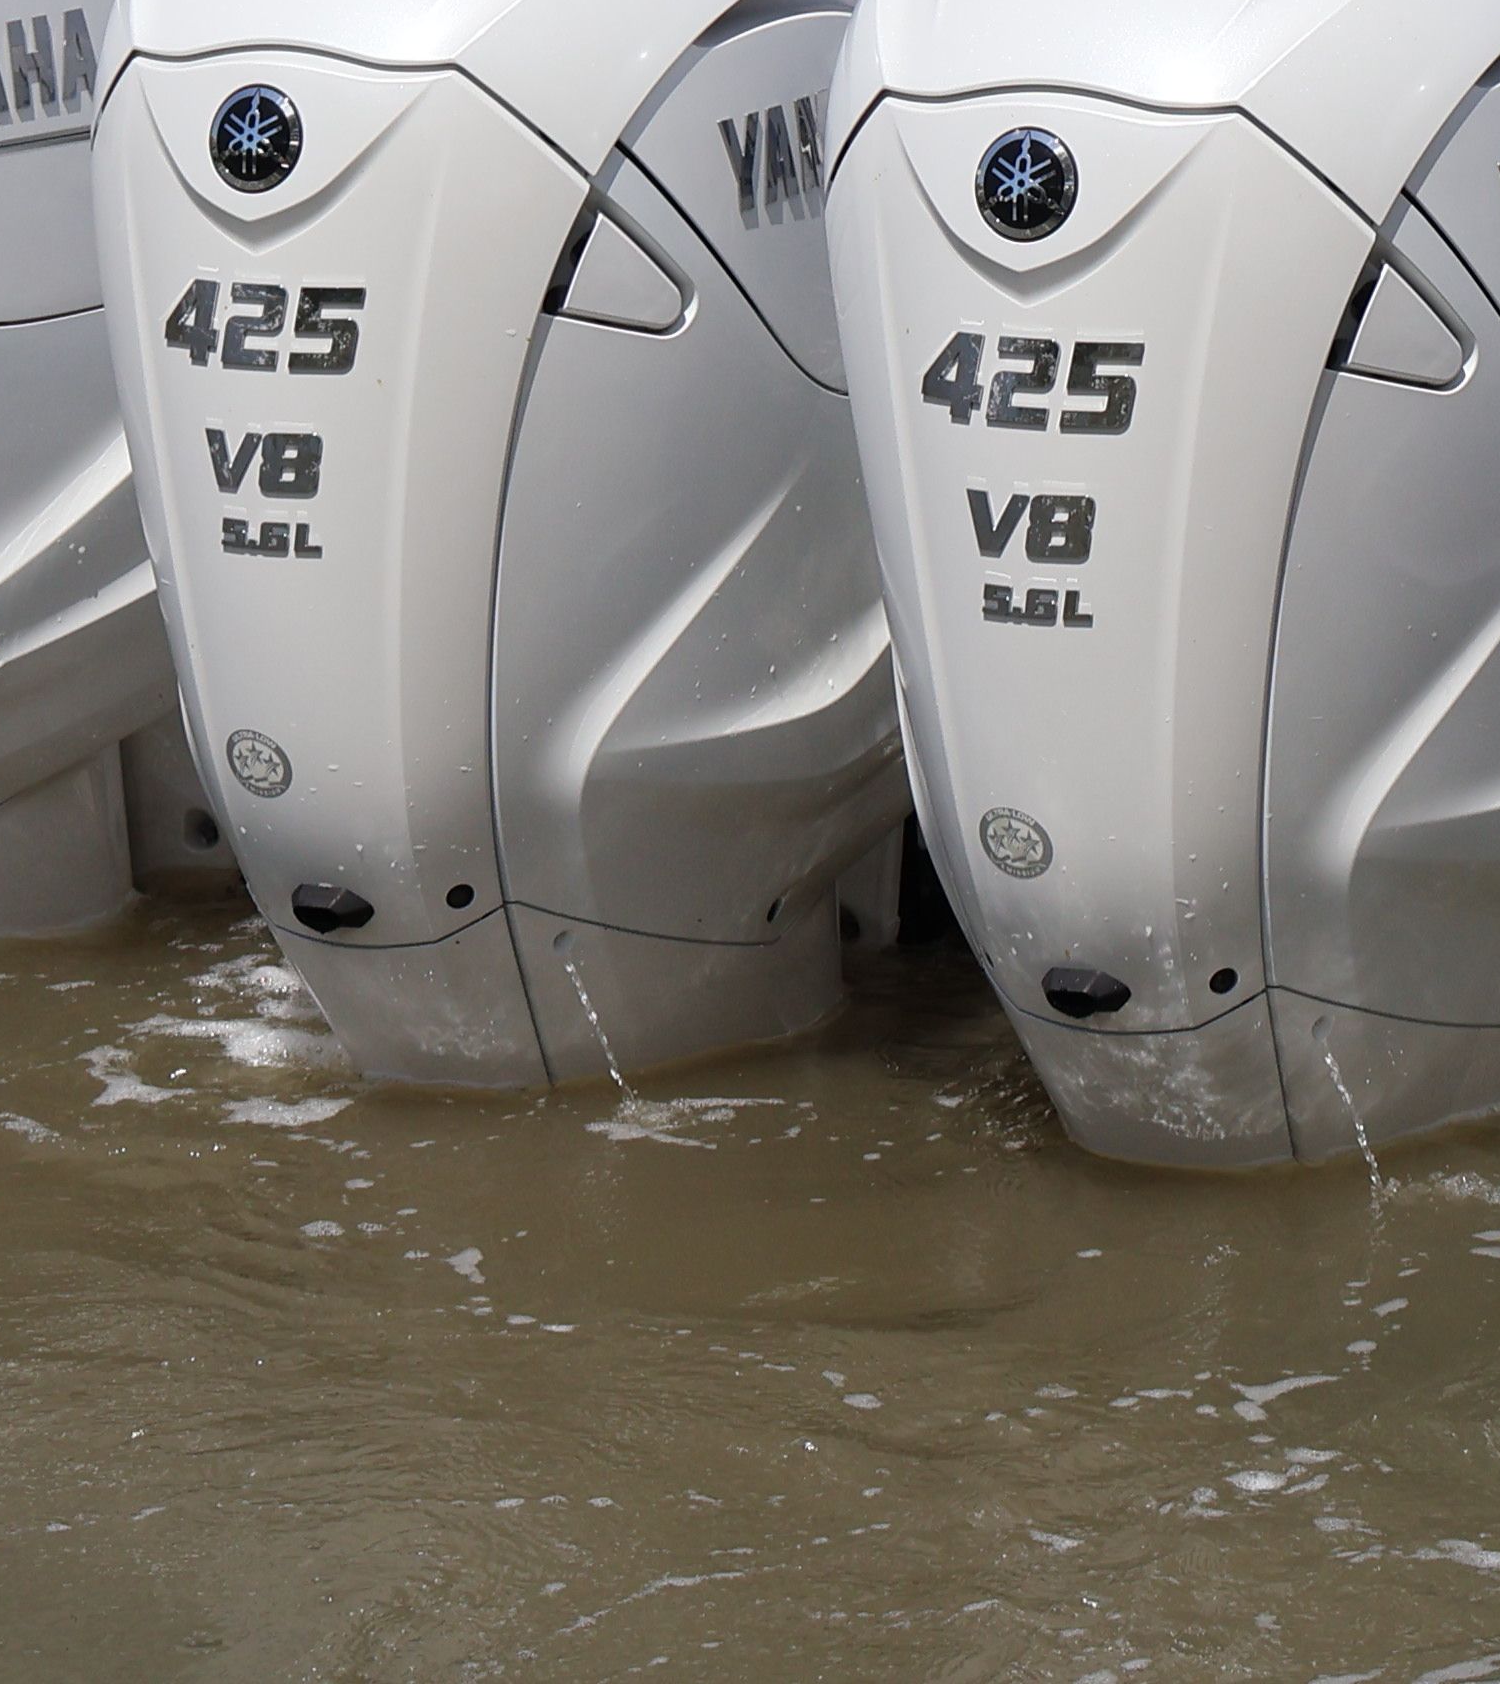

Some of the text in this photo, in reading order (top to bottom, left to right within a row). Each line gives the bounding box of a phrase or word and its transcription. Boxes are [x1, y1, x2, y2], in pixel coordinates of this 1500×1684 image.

[164, 278, 366, 375] 425
[921, 331, 1145, 435] 425
[205, 427, 323, 499] V8
[966, 488, 1096, 565] V8
